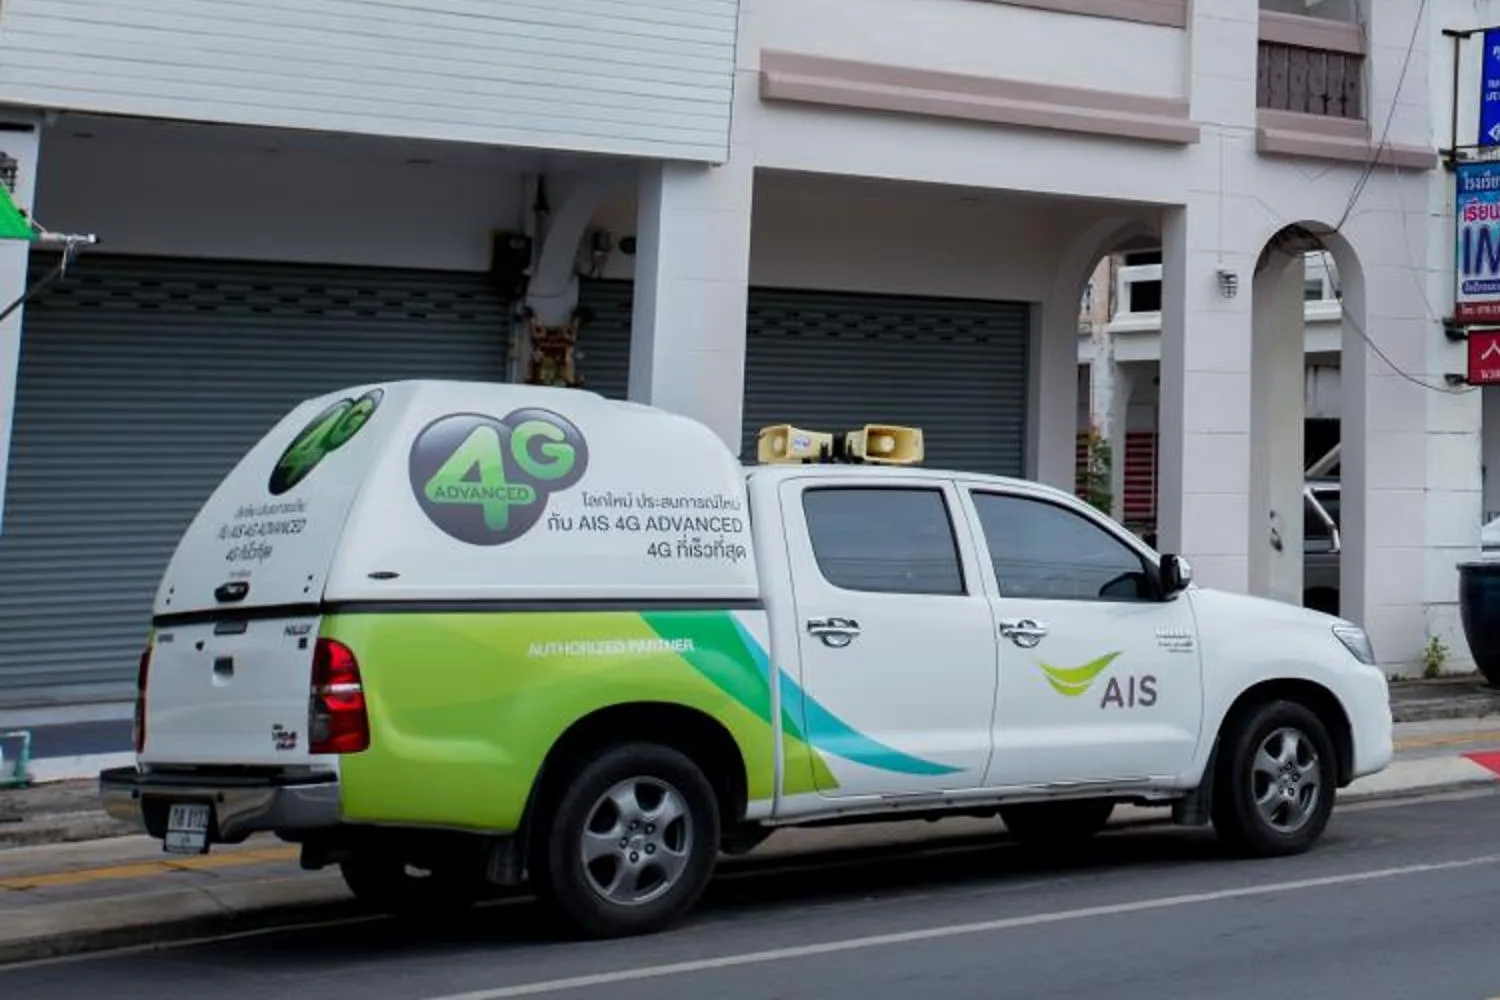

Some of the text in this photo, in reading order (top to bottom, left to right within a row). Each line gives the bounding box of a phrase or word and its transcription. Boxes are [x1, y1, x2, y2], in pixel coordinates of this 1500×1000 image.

[433, 485, 530, 501] ADVANCED
[547, 513, 743, 533] กับ AIS 4G ADVANCED
[647, 534, 748, 563] 4G ที่เร็วที่สุด
[1100, 675, 1158, 710] AIS
